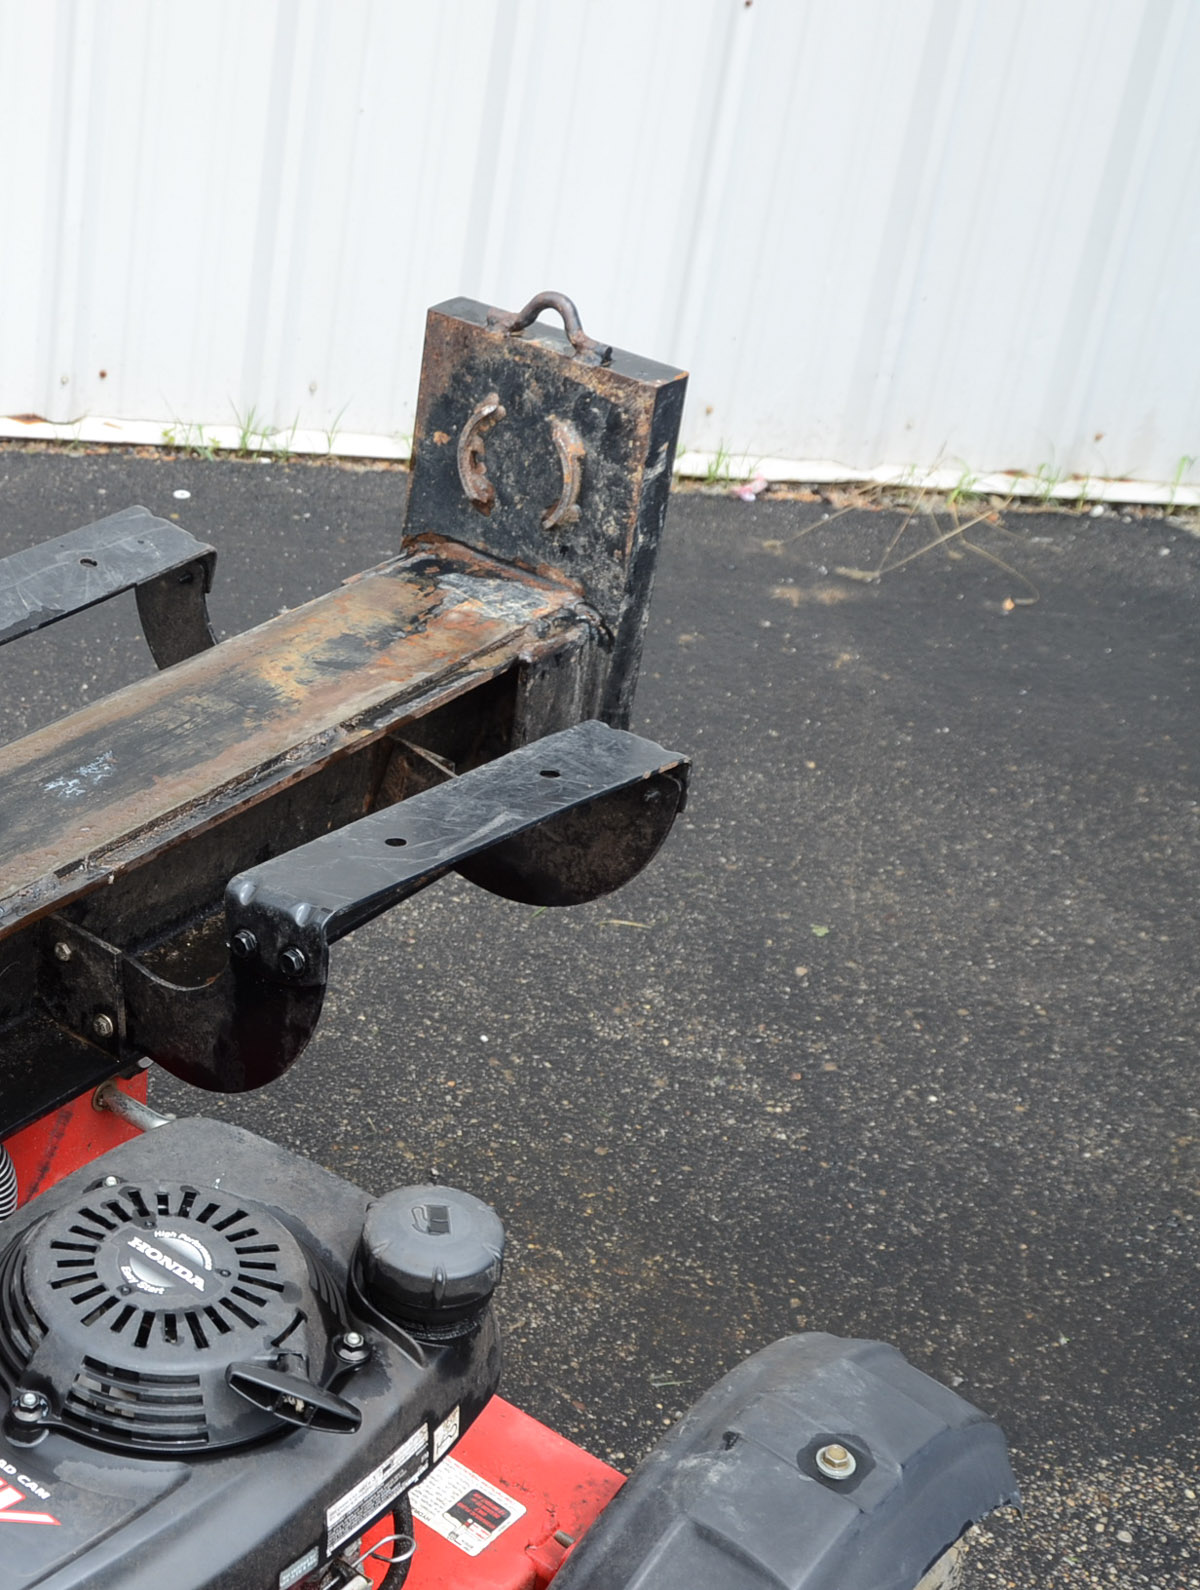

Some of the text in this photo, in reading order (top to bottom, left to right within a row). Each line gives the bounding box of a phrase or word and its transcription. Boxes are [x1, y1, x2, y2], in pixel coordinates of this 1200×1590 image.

[154, 1230, 177, 1239] High
[127, 1236, 205, 1292] HONDA
[137, 1281, 165, 1295] Start
[16, 1474, 51, 1500] CAM
